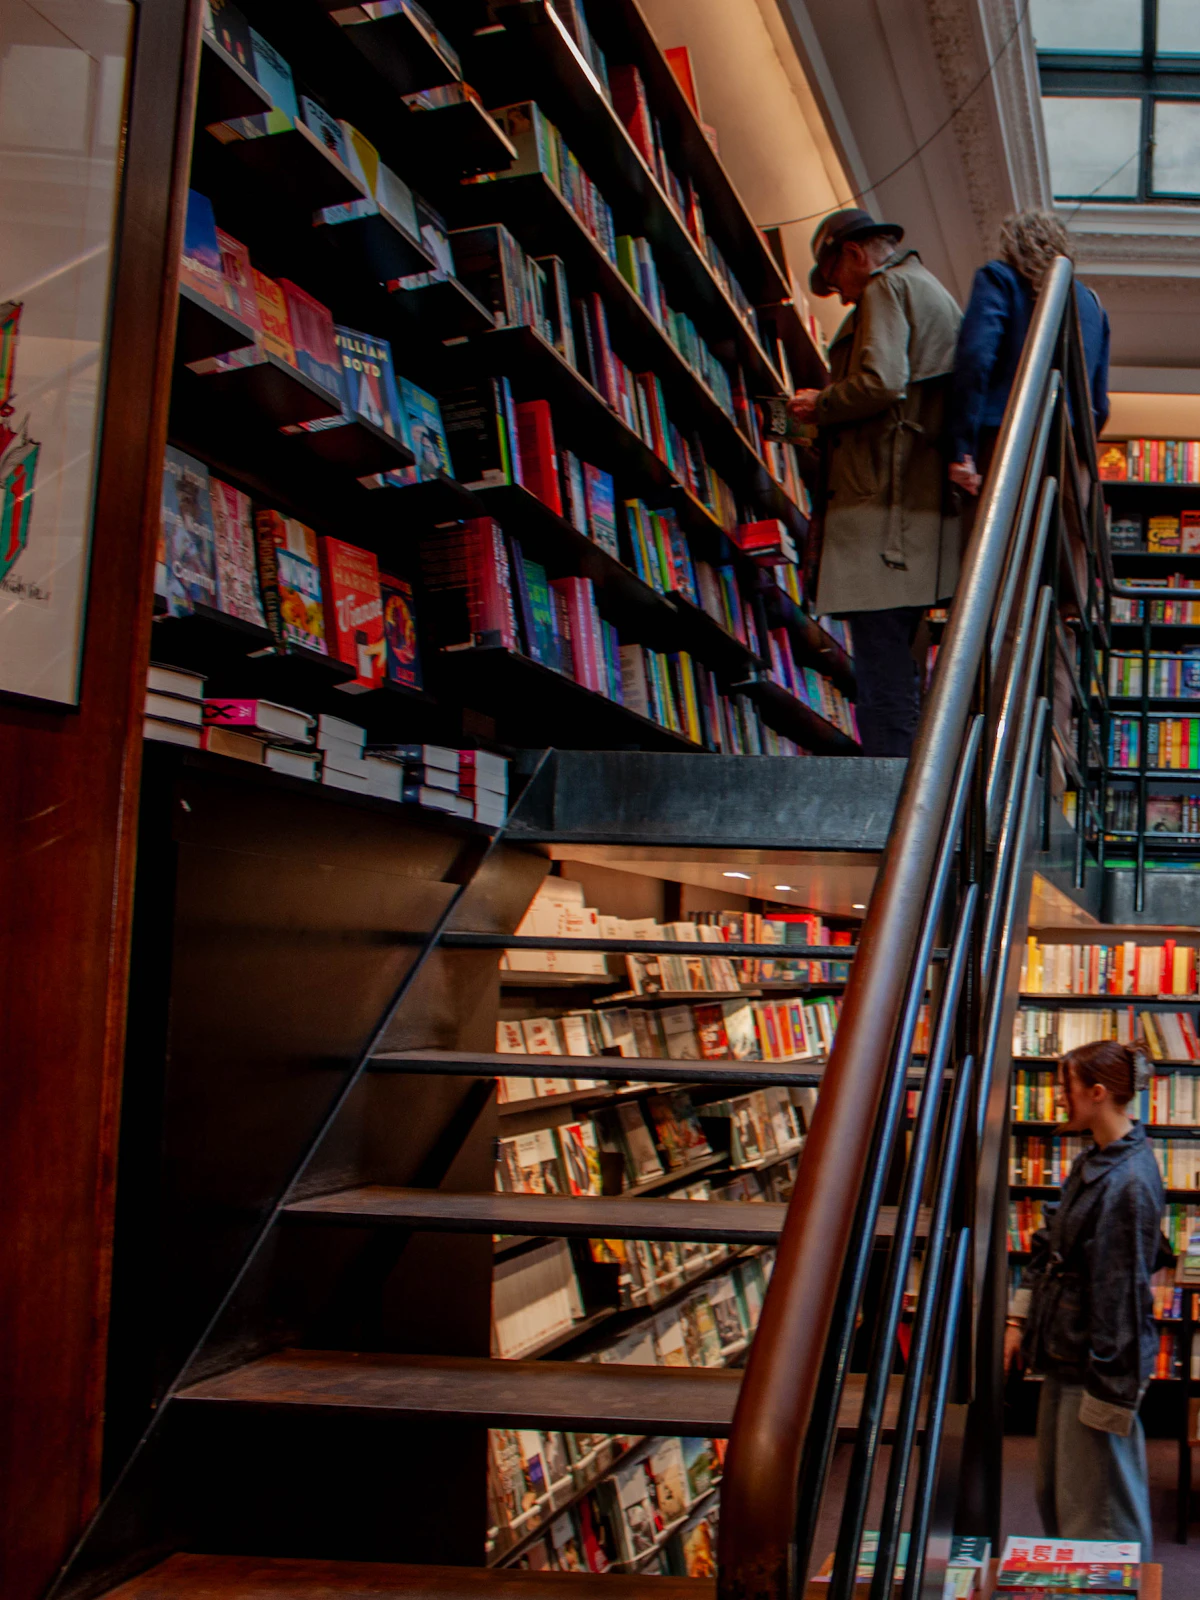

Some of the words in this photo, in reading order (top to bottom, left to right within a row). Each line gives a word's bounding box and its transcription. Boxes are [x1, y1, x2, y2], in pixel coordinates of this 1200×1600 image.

[342, 354, 382, 378] BOYD
[172, 559, 216, 596] Country
[332, 567, 381, 598] HARRIS
[1032, 1545, 1052, 1561] OFFER
